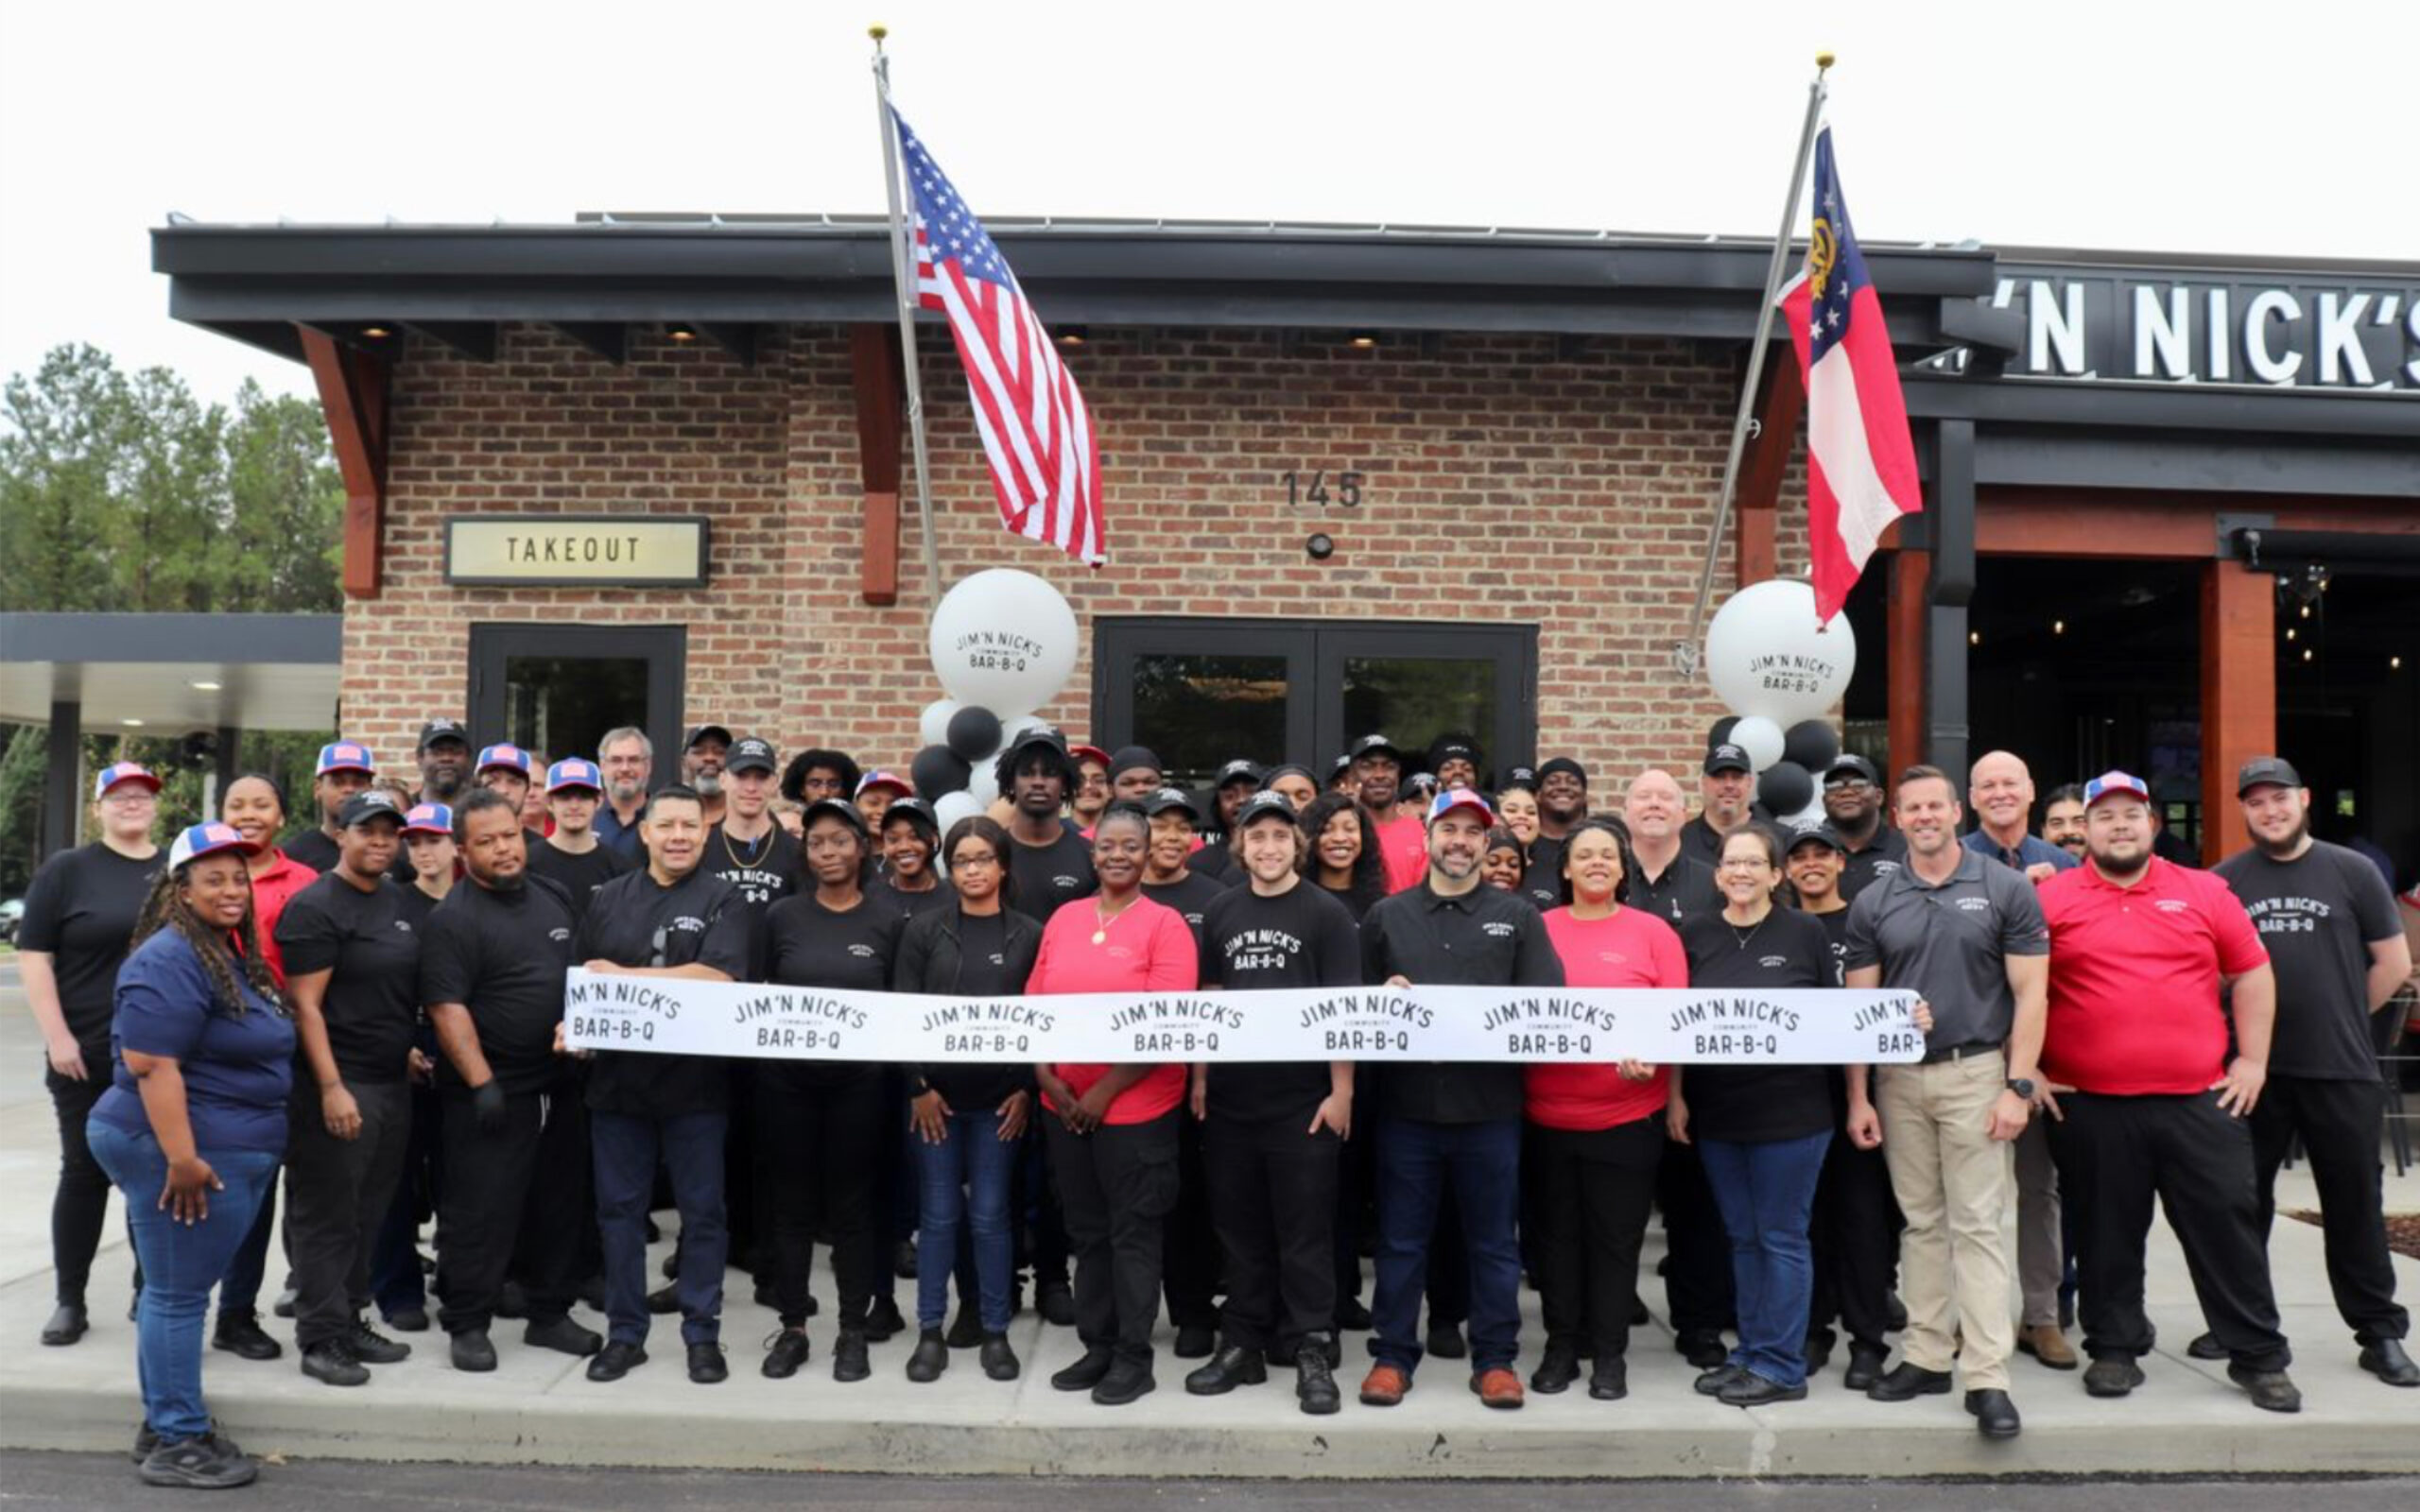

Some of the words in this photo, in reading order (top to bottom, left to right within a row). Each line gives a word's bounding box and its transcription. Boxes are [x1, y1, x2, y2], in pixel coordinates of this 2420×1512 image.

[2134, 285, 2420, 386] NICK'
[1283, 471, 1361, 507] 145
[507, 537, 639, 561] TAKEOUT
[998, 631, 1043, 658] NICK'S
[970, 653, 1026, 672] BAR-B-Q
[1763, 676, 1819, 693] BAR-B-Q
[2258, 918, 2313, 933] BAR-B-Q
[1258, 929, 1302, 954] NICK'S
[1234, 953, 1285, 971] BAR-B-Q
[614, 983, 682, 1019] NICK'S
[801, 995, 868, 1029] NICK'S
[1366, 995, 1434, 1029] NICK'S
[988, 1004, 1055, 1032] NICK'S
[1176, 999, 1244, 1029] NICK'S
[1548, 998, 1616, 1032] NICK'S
[1734, 998, 1801, 1032] NICK'S
[574, 1016, 654, 1040] BAR-B-Q
[757, 1027, 840, 1049] BAR-B-Q
[945, 1034, 1028, 1052] BAR-B-Q
[1134, 1033, 1219, 1052] BAR-B-Q
[1325, 1031, 1409, 1051] BAR-B-Q
[1509, 1035, 1592, 1054] BAR-B-Q
[1695, 1035, 1777, 1054] BAR-B-Q
[1878, 1034, 1922, 1053] BAR-
